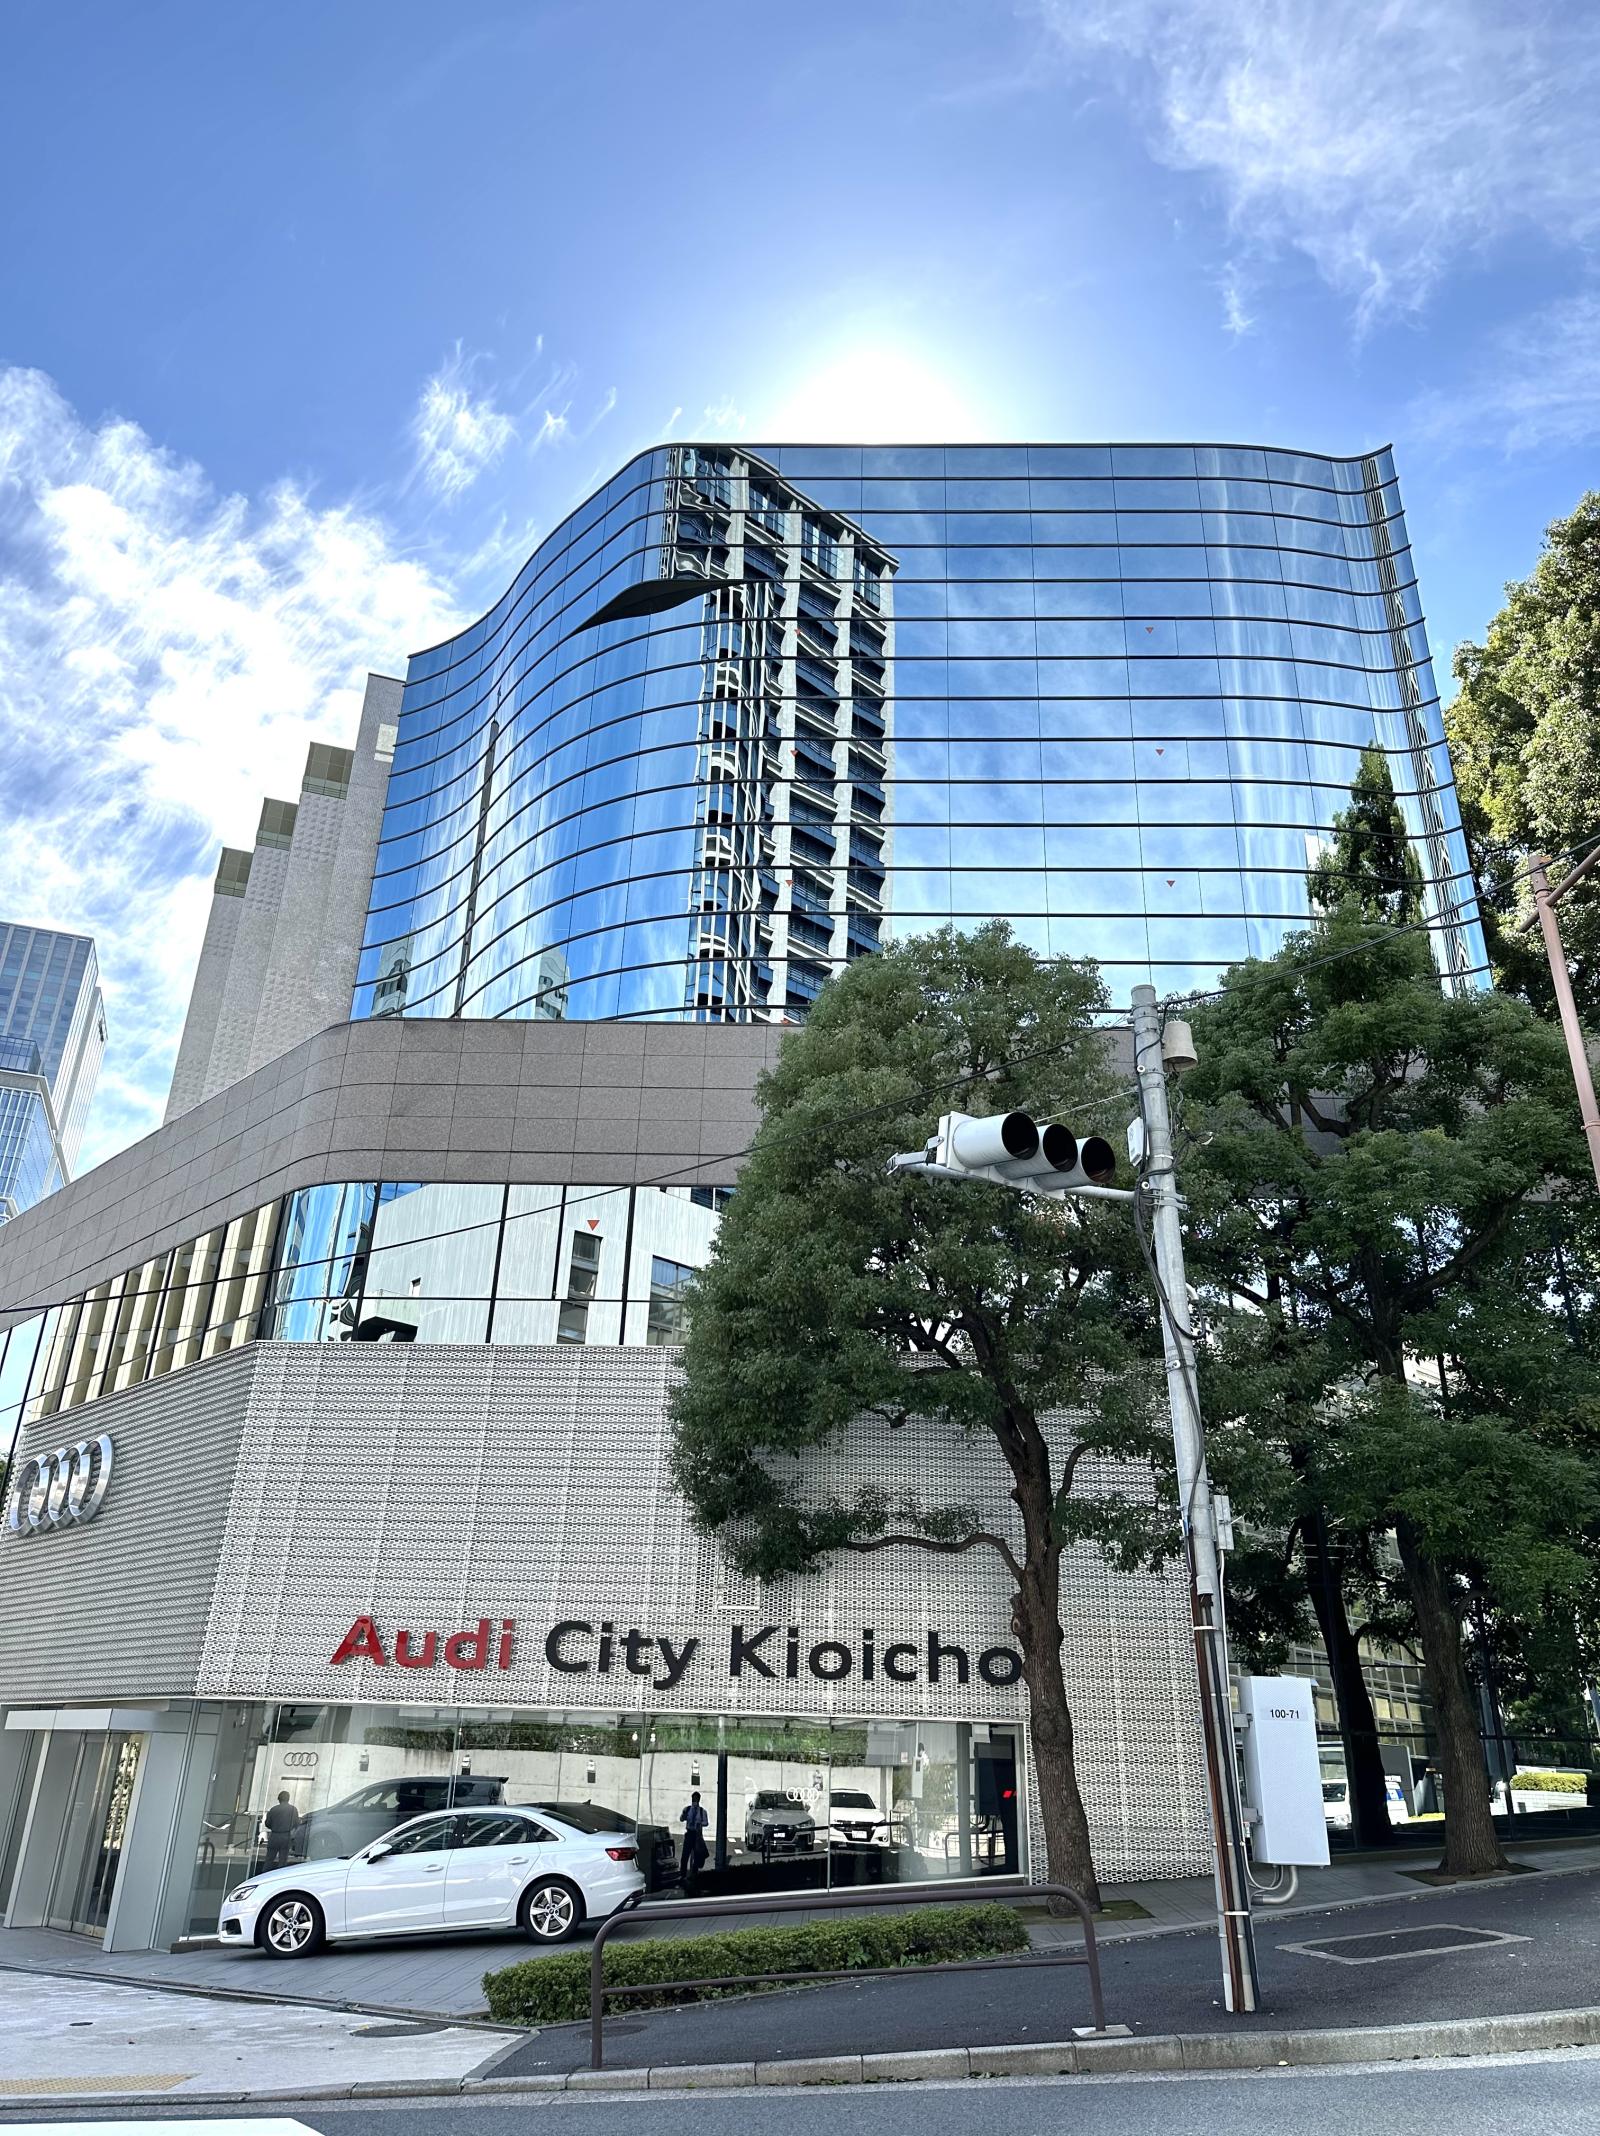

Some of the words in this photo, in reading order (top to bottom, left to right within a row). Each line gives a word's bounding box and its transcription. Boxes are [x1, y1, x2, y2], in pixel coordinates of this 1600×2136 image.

[329, 1615, 516, 1670] Audi
[545, 1619, 699, 1690] City
[729, 1625, 1024, 1686] Kioicho
[1269, 1709, 1300, 1719] 100-71
